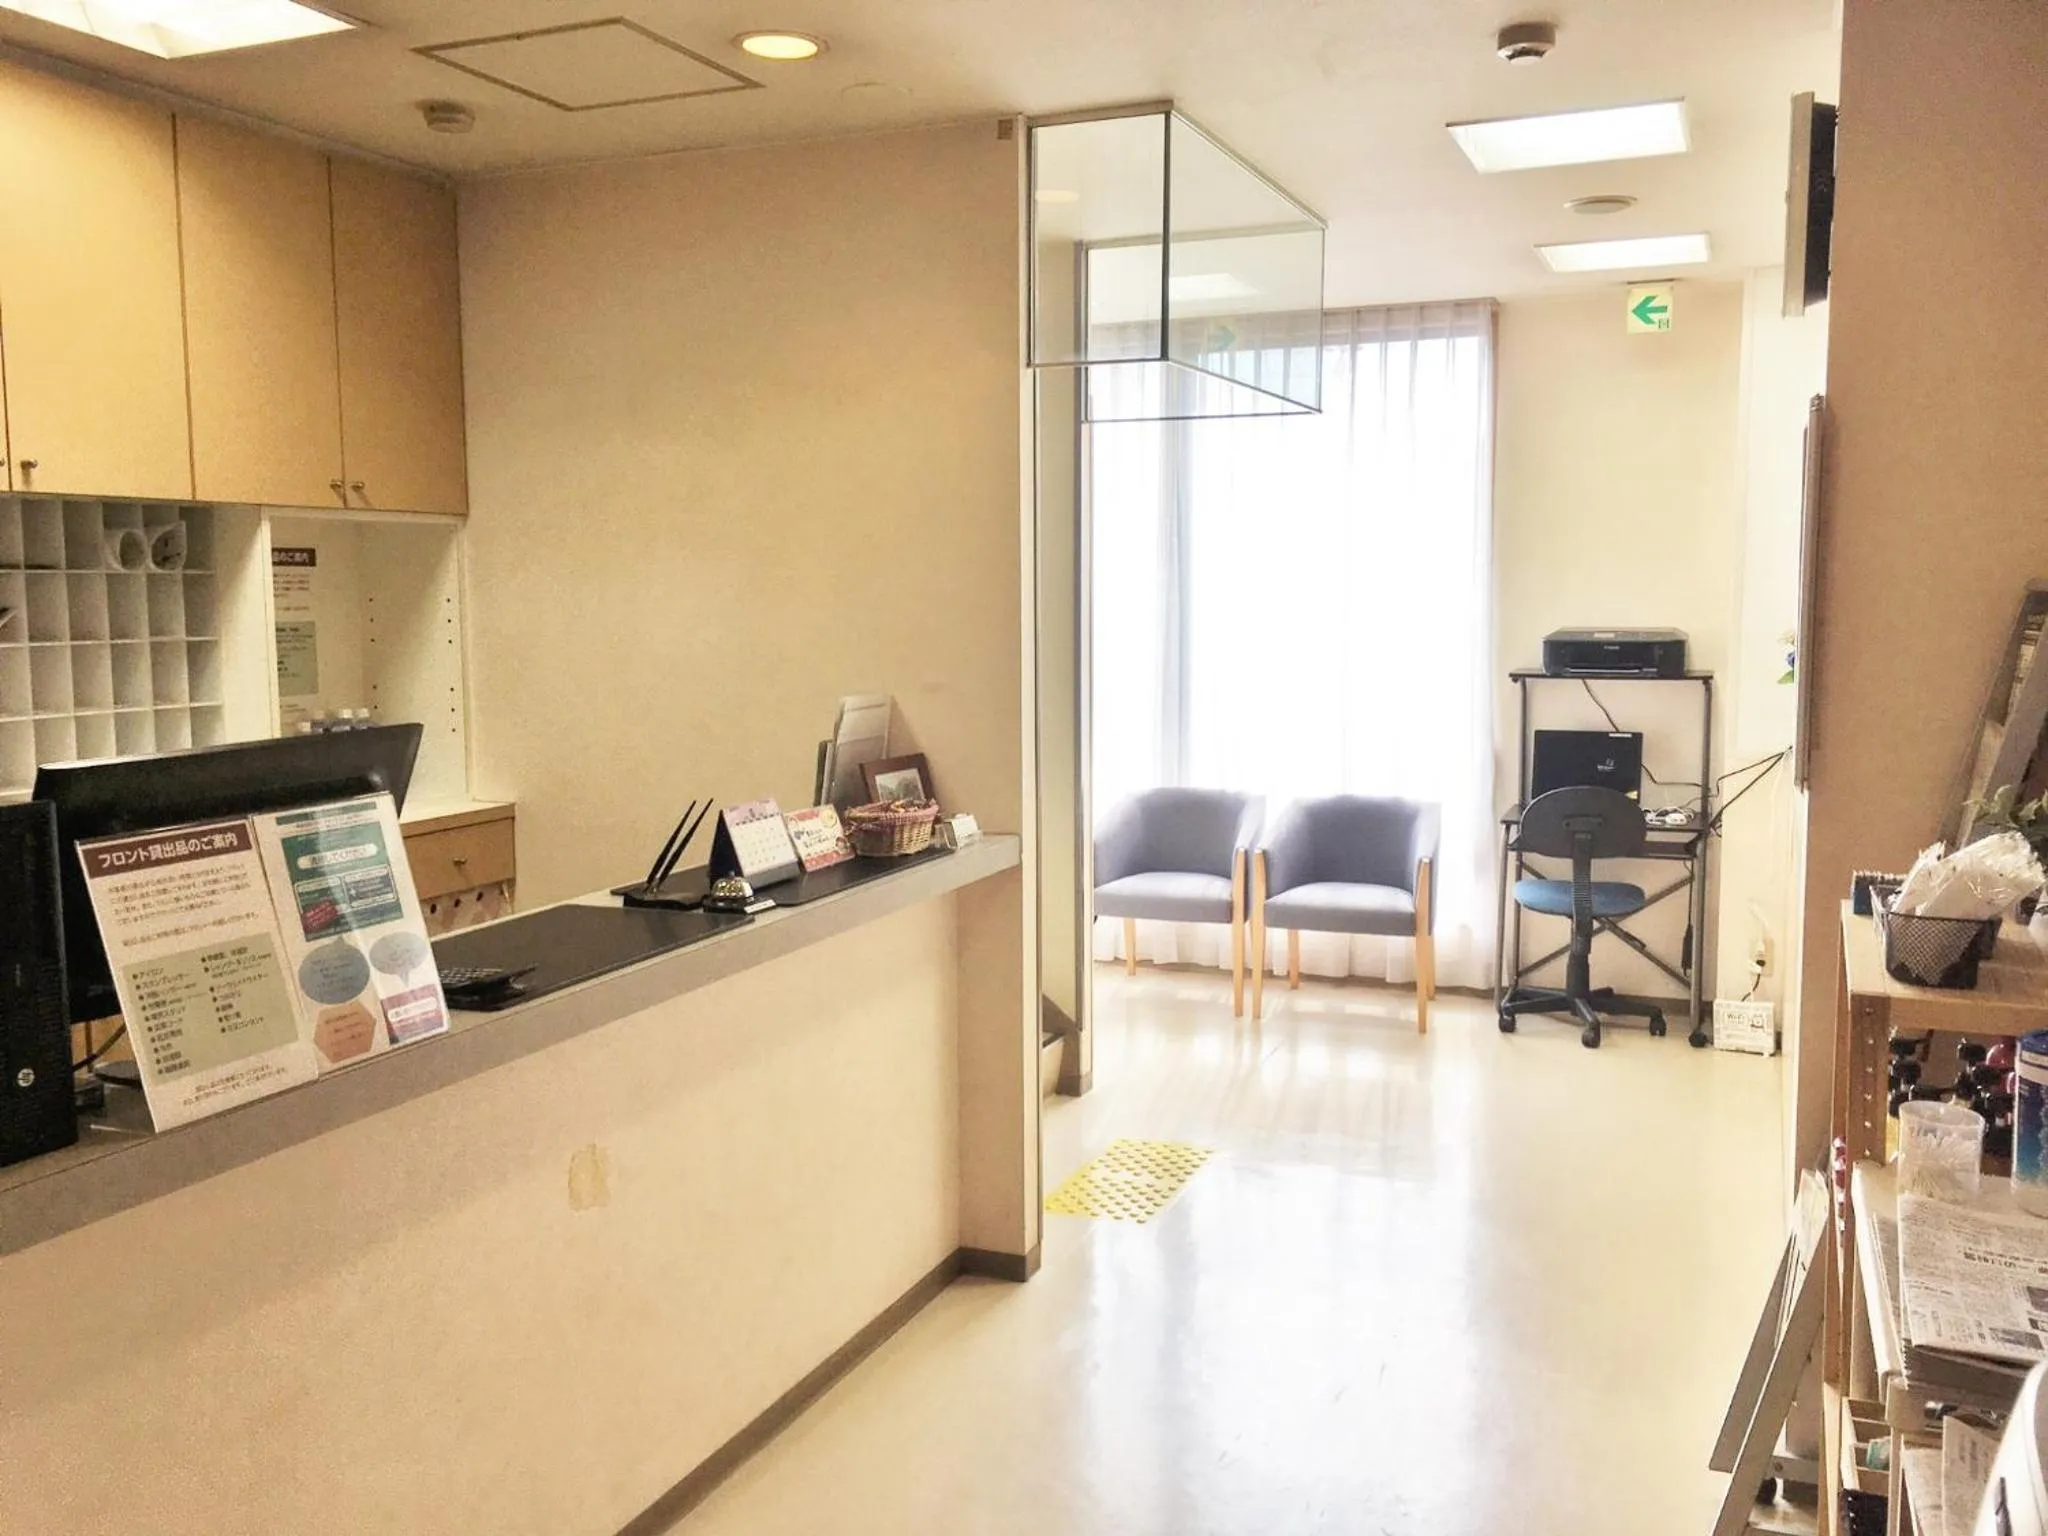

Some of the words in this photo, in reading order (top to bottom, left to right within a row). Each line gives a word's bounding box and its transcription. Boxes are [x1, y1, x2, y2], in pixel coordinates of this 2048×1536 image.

[98, 832, 238, 868] フロント貸出品のご案内
